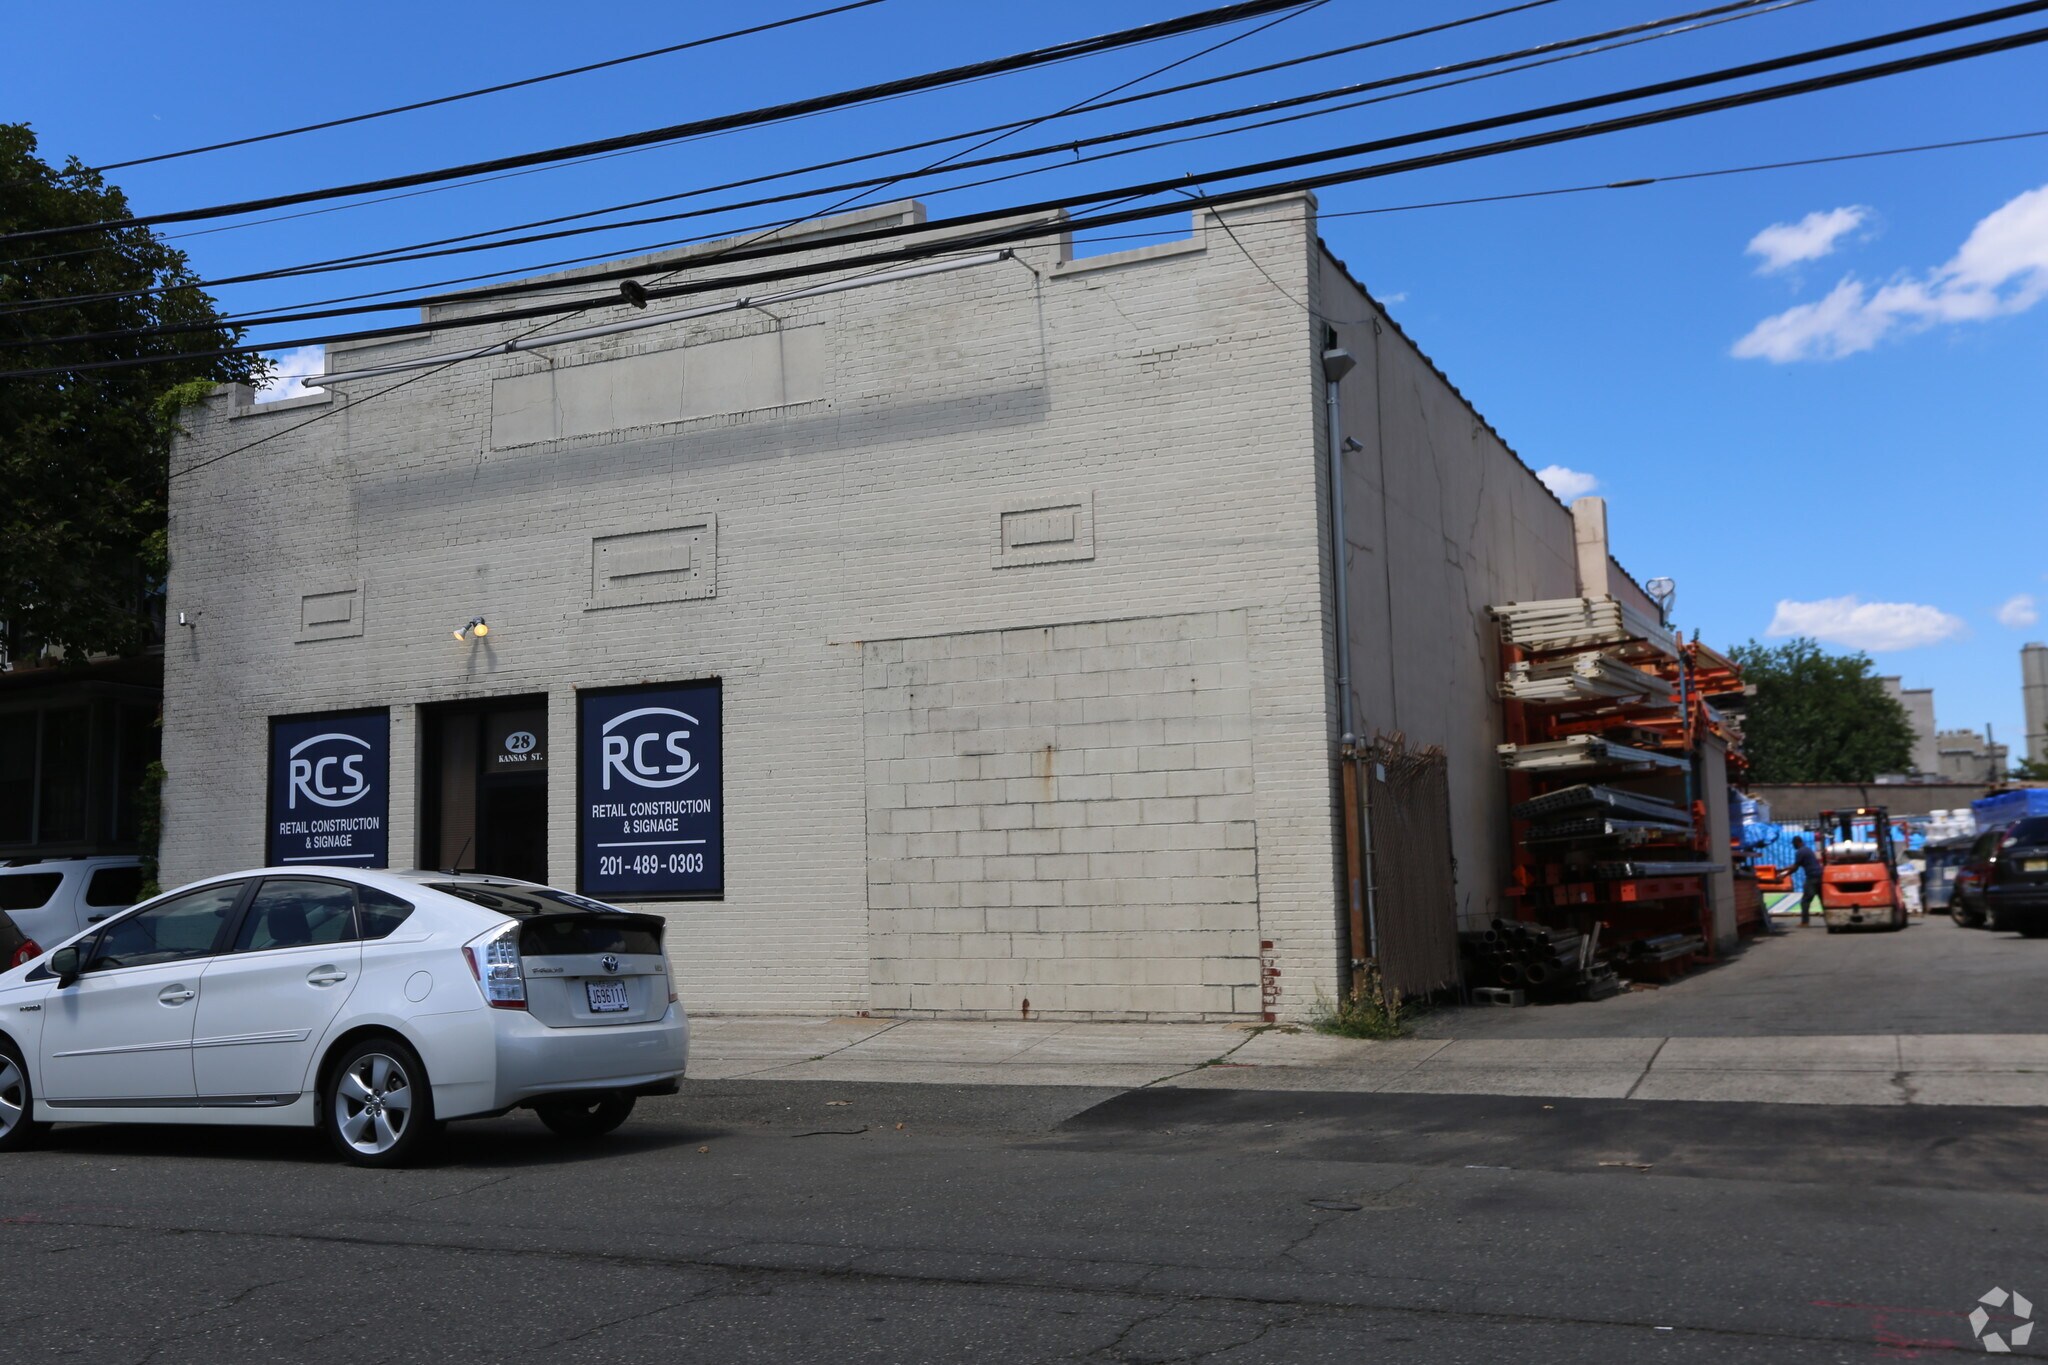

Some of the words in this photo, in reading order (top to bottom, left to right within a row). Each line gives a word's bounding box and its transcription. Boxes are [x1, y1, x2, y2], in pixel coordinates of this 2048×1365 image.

[511, 735, 531, 749] 28
[498, 753, 527, 763] KANSAS
[531, 752, 543, 761] ST.
[602, 730, 700, 790] RCS
[289, 754, 370, 809] RCS
[592, 804, 627, 818] RETAIL
[629, 799, 711, 817] CONSTRUCTION
[279, 821, 309, 835] RETAIL
[311, 817, 379, 833] CONSTRUCTION
[623, 821, 631, 834] &
[633, 818, 679, 834] SIGNAGE
[305, 836, 312, 849] &
[313, 834, 352, 849] SIGNAGE
[592, 988, 625, 1004] J696111
